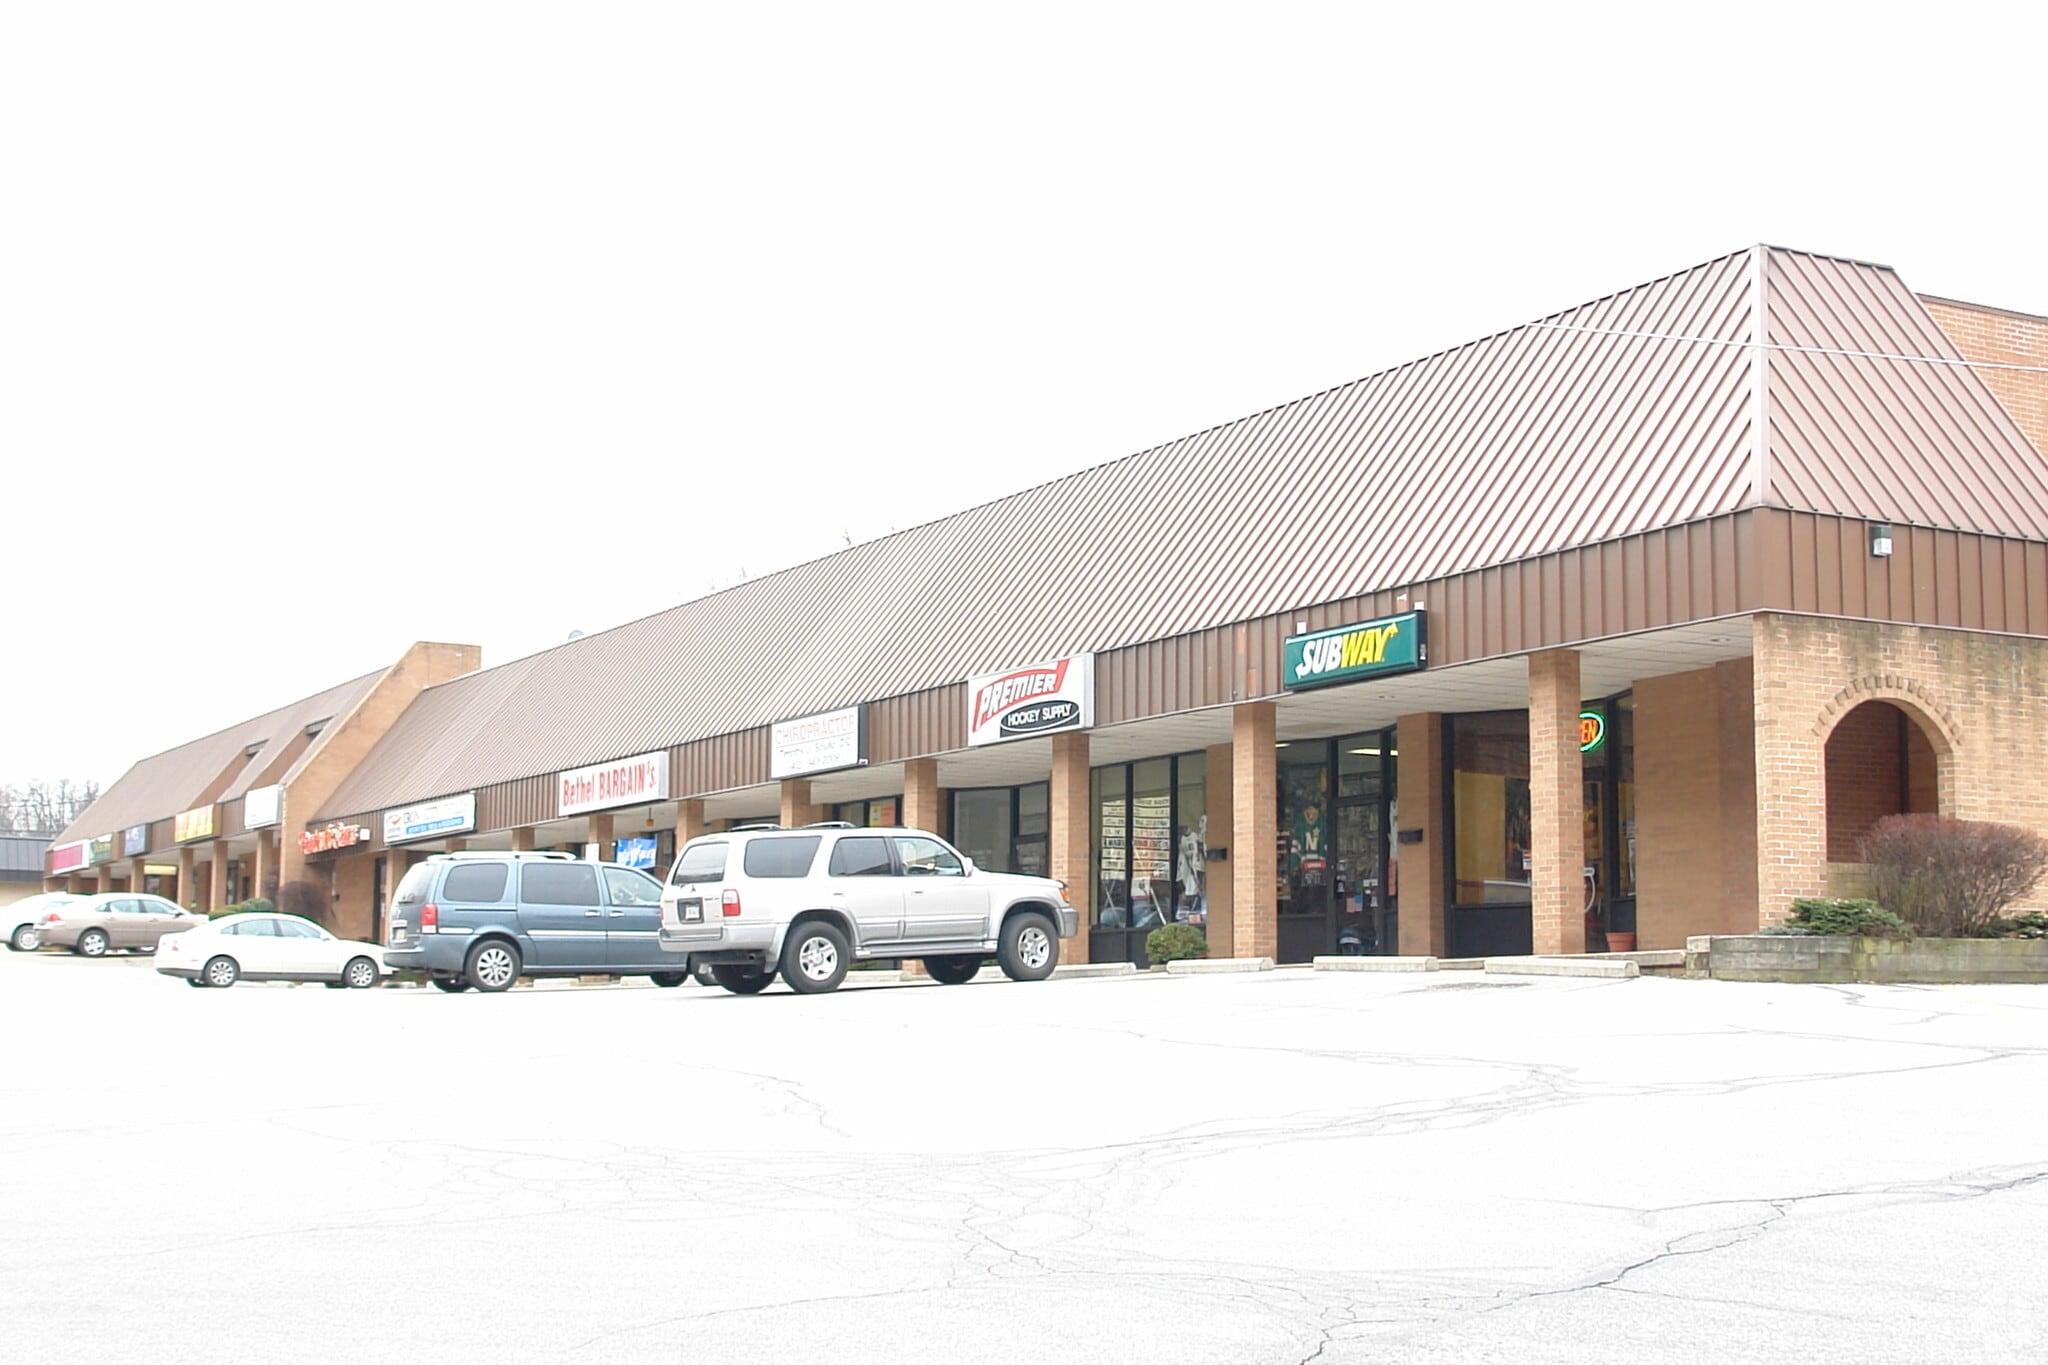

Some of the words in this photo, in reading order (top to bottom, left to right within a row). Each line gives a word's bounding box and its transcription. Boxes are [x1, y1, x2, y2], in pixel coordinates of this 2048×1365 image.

[1295, 622, 1399, 679] SUBWAY
[976, 672, 1059, 730] PREMIER
[1008, 709, 1041, 727] HOCKEY
[1042, 704, 1073, 721] SUPPLY
[775, 714, 856, 745] CHIROPRACTOR
[1578, 719, 1599, 744] EN
[563, 773, 595, 807] Bethel
